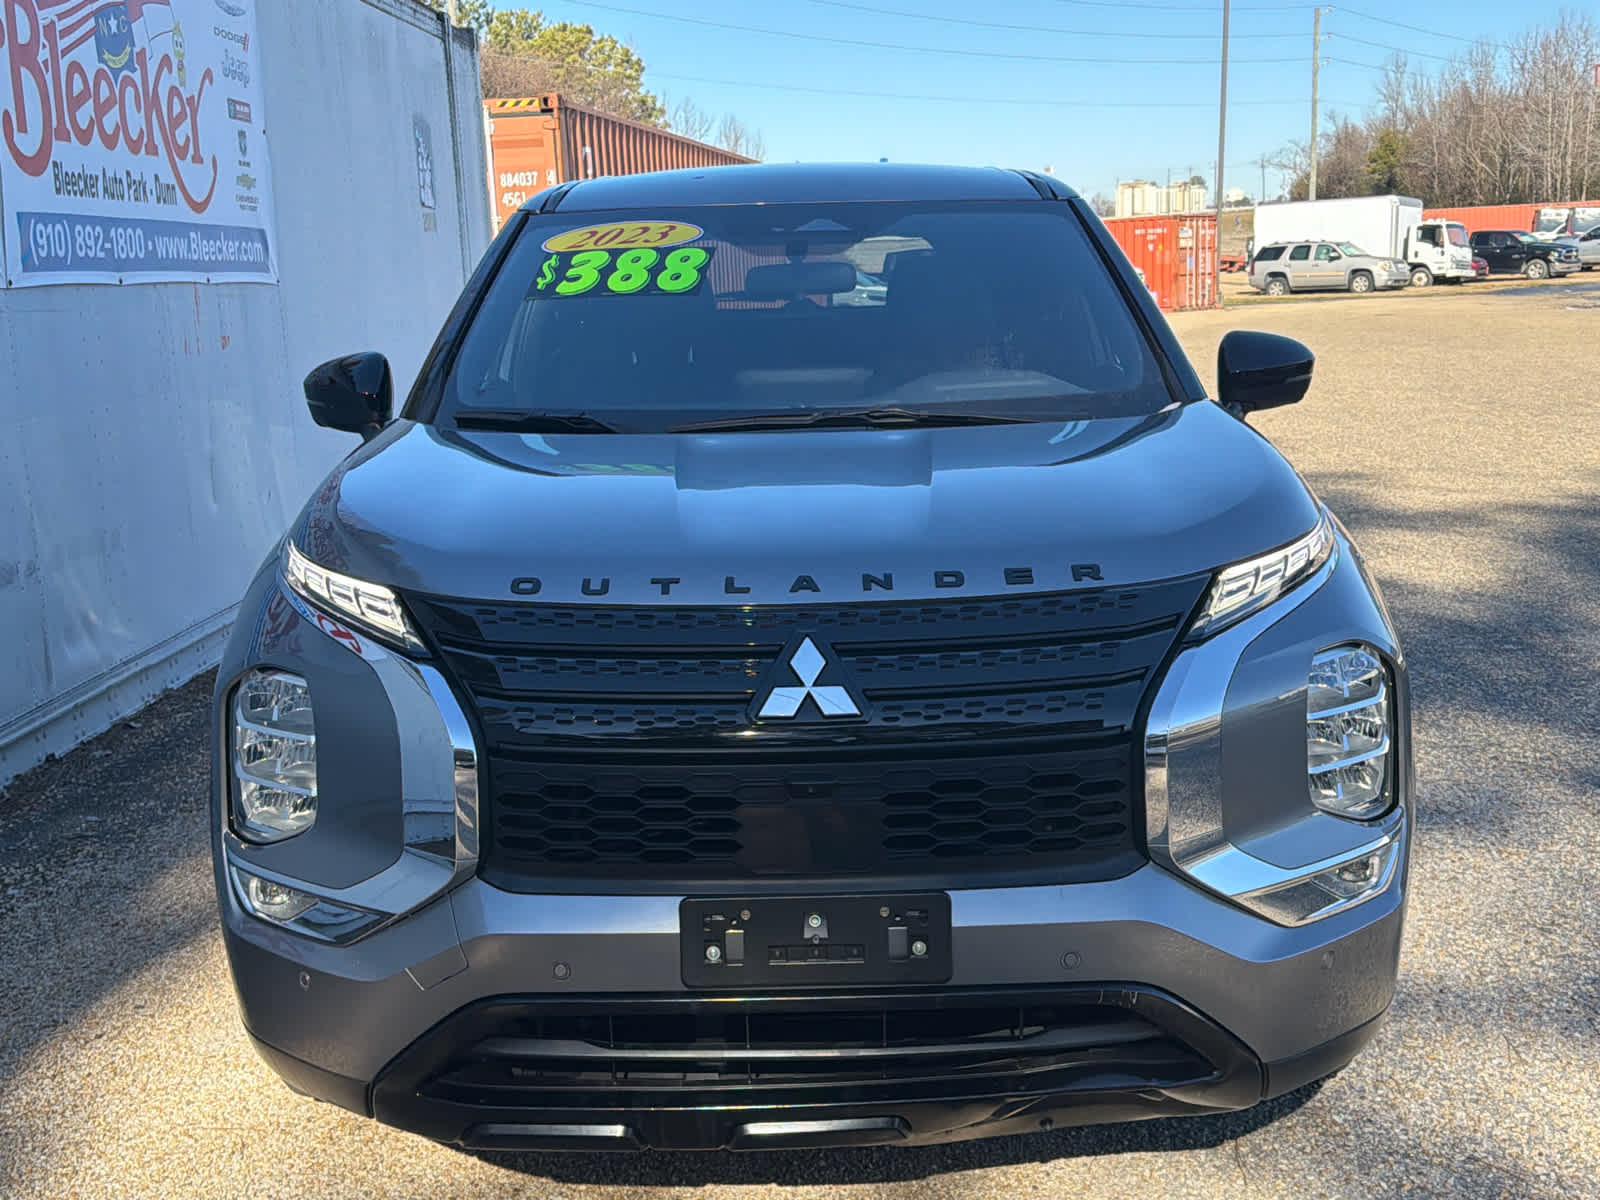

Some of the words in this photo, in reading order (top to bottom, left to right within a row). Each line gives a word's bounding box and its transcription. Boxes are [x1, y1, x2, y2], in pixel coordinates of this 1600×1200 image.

[1, 0, 217, 214] Bleecker
[52, 160, 100, 199] Bleecker
[102, 166, 125, 200] Auto
[126, 169, 149, 203] Park
[154, 174, 178, 205] Dunn
[29, 219, 72, 265] (910)
[75, 225, 145, 259] 892-1800
[154, 231, 264, 263] www.Bleecker.com
[565, 225, 677, 249] 2023
[536, 248, 710, 296] $388
[510, 563, 1105, 596] OUTLANDER
